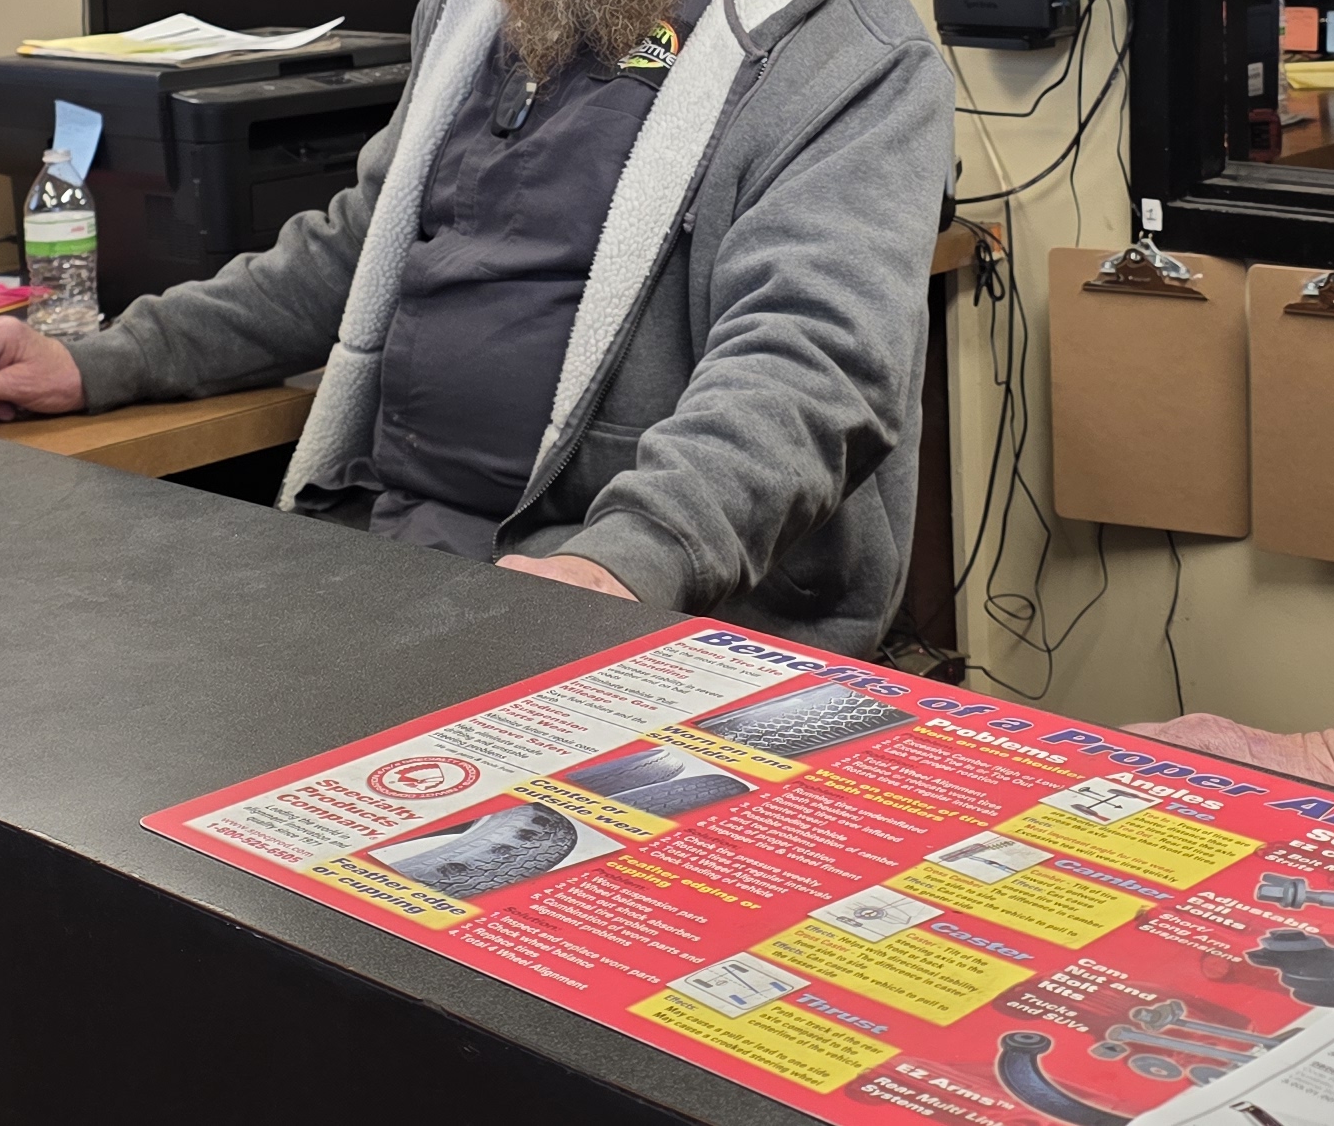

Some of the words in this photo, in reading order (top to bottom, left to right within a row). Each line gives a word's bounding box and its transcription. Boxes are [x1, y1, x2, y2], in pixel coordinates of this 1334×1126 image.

[692, 631, 911, 698] Benefits
[917, 696, 1002, 717] of
[987, 711, 1034, 733] a
[1040, 727, 1271, 799] Proper
[646, 733, 740, 762] shoulder
[661, 725, 717, 746] Worn
[719, 746, 748, 756] on
[750, 756, 793, 770] one
[913, 726, 954, 741] Worn
[956, 740, 977, 748] on
[979, 747, 1010, 757] one
[1012, 756, 1085, 779] shoulder
[925, 718, 1068, 763] Problems
[295, 786, 399, 827] Products
[315, 779, 424, 820] Specialty
[530, 779, 601, 805] Center
[601, 806, 628, 814] or
[815, 769, 857, 785] Worn
[859, 784, 881, 793] on
[883, 792, 936, 810] center
[959, 815, 989, 827] tire
[824, 780, 861, 795] both
[863, 793, 944, 821] shoulders
[1099, 772, 1224, 810] Angles
[513, 787, 593, 815] outside
[595, 815, 653, 836] wear
[1165, 802, 1215, 821] Toe
[207, 823, 303, 863] 1-800-525-6505
[221, 817, 314, 858] www.specprod.com
[1289, 840, 1318, 852] EZ
[606, 861, 672, 888] cupping
[1054, 859, 1174, 899] Camber
[1265, 855, 1314, 872] Struts
[1287, 853, 1323, 867] Bolt
[312, 866, 339, 876] or
[338, 877, 427, 914] cupping
[329, 857, 412, 891] Feather
[411, 892, 466, 915] edge
[579, 881, 615, 897] Wheel
[611, 894, 653, 913] balance
[591, 876, 621, 890] Worn
[619, 888, 678, 912] suspension
[676, 911, 708, 923] parts
[618, 855, 680, 879] Feather
[681, 879, 739, 902] edging
[740, 901, 761, 909] or
[1159, 913, 1214, 932] Short/
[1176, 905, 1246, 930] Joints
[1187, 897, 1232, 914] Ball
[1197, 892, 1320, 933] Adjustable
[931, 922, 1034, 960] Caster
[1139, 924, 1248, 962] Suspensions
[1148, 919, 1192, 936] Long
[1193, 935, 1231, 949] Arm
[1051, 973, 1098, 993] Bolt
[1064, 965, 1107, 984] Nut
[1109, 983, 1157, 1001] and
[1078, 958, 1128, 979] Cam
[1021, 993, 1078, 1017] Trucks
[1038, 980, 1085, 1001] Kits
[796, 993, 888, 1034] Thrust
[1006, 1001, 1044, 1015] and
[1042, 1013, 1089, 1032] SUVs
[861, 1084, 934, 1116] Systems
[873, 1076, 916, 1096] Rear
[916, 1093, 967, 1115] Multi
[897, 1063, 929, 1078] EZ
[929, 1078, 1015, 1110] Arms™
